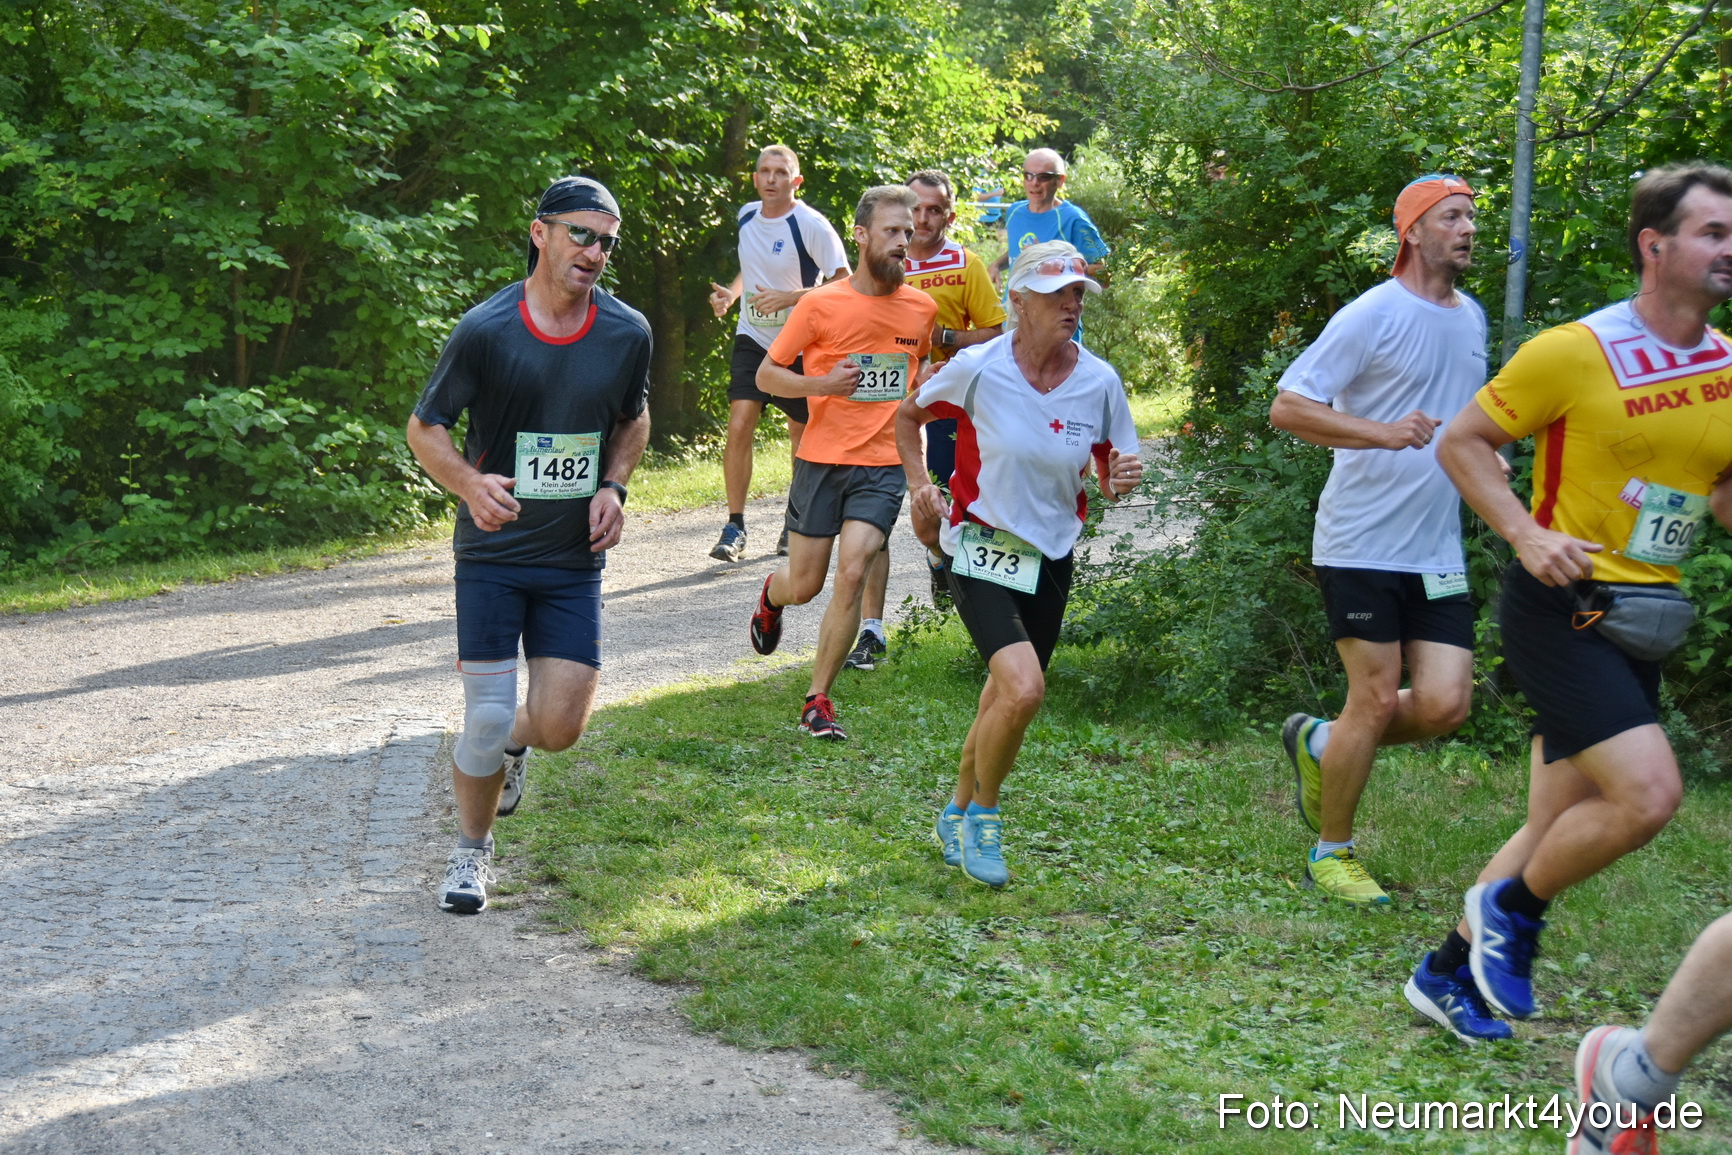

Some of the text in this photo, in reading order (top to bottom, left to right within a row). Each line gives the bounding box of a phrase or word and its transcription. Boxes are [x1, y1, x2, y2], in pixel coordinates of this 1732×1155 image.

[920, 274, 966, 289] BÖGL
[857, 370, 900, 388] 2312
[1623, 375, 1732, 418] MAX BÖ
[1067, 420, 1094, 429] Bayerisches
[1066, 437, 1079, 446] Eva
[527, 456, 590, 481] 1482
[560, 480, 577, 488] Josef
[972, 546, 1020, 575] 373
[1355, 612, 1373, 621] cep
